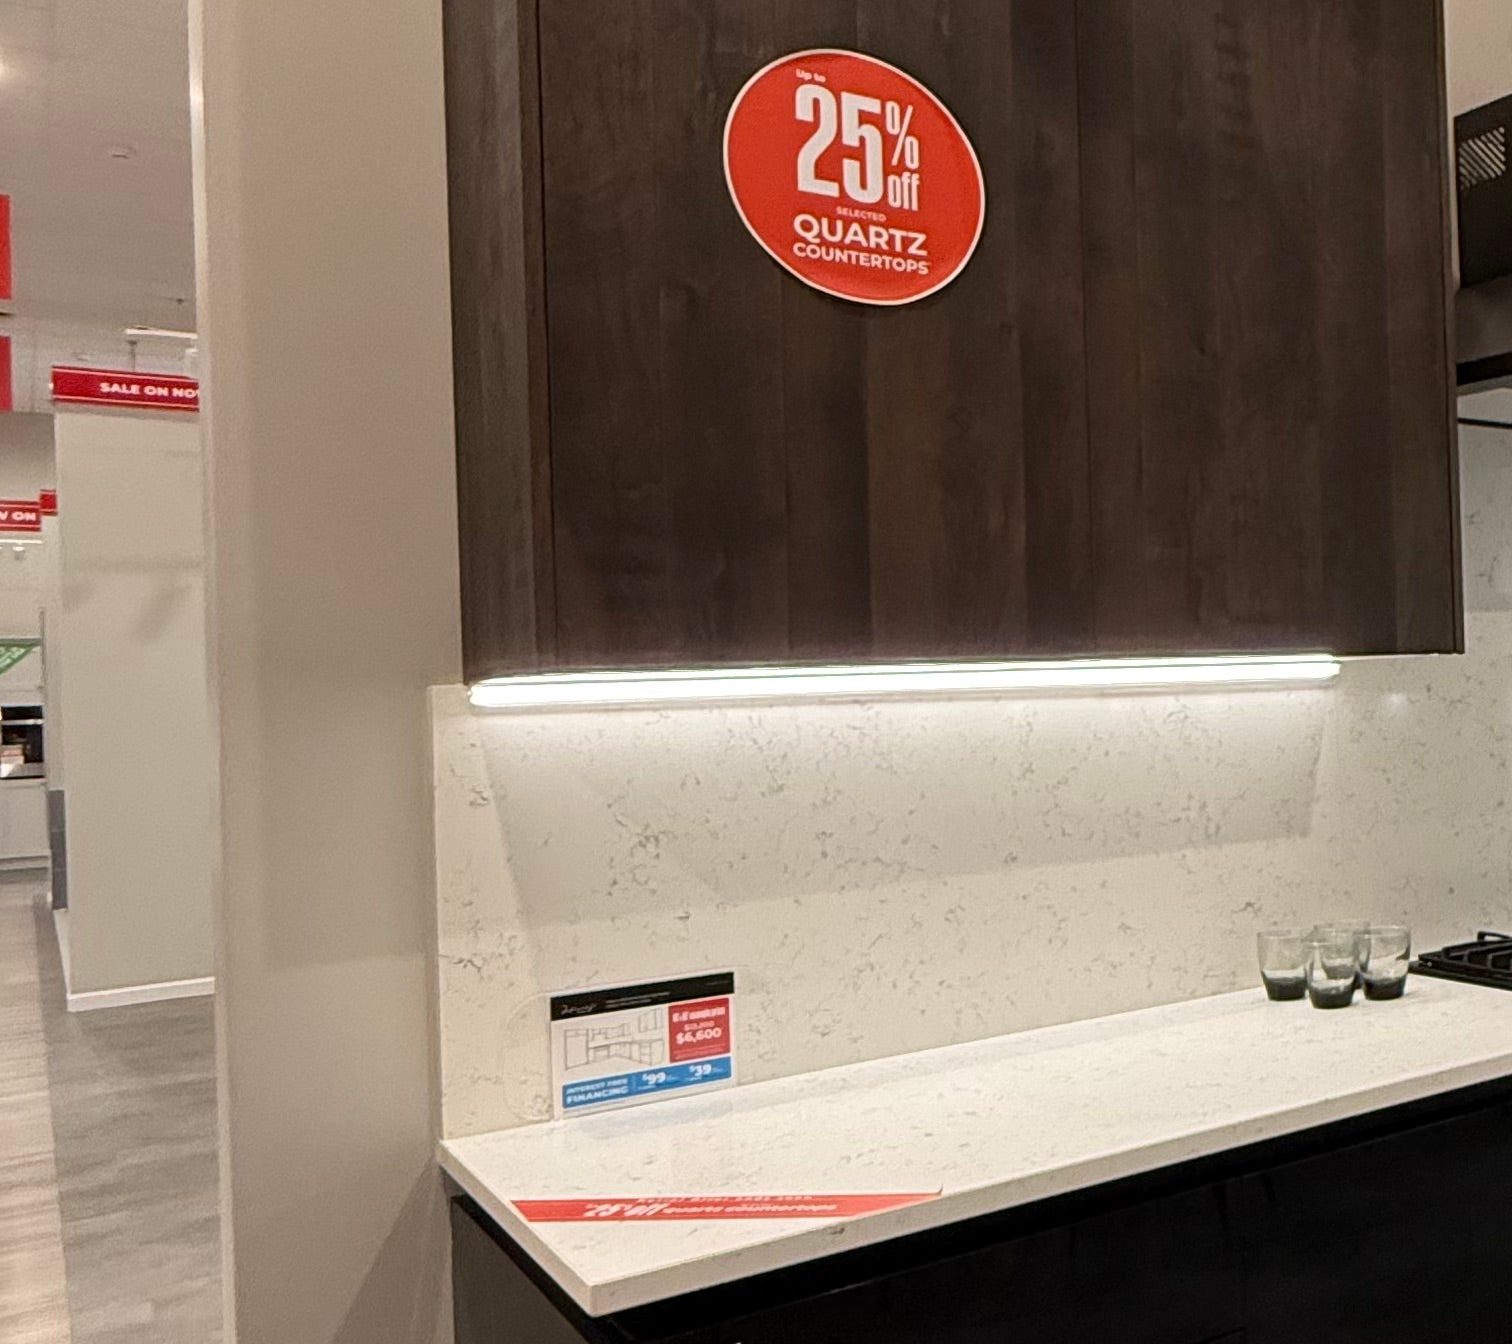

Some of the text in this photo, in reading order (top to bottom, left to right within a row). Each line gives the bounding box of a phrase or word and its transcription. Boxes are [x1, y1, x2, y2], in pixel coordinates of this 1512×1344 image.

[796, 69, 826, 83] Up to
[887, 172, 920, 211] off
[836, 207, 886, 222] SELECTED
[793, 214, 928, 256] QUARTZ
[793, 243, 929, 275] COUNTERTOPS
[100, 382, 199, 399] SALE ON NO
[11, 511, 36, 521] ON
[676, 1028, 722, 1045] $6,600
[566, 1086, 629, 1105] FINANCING
